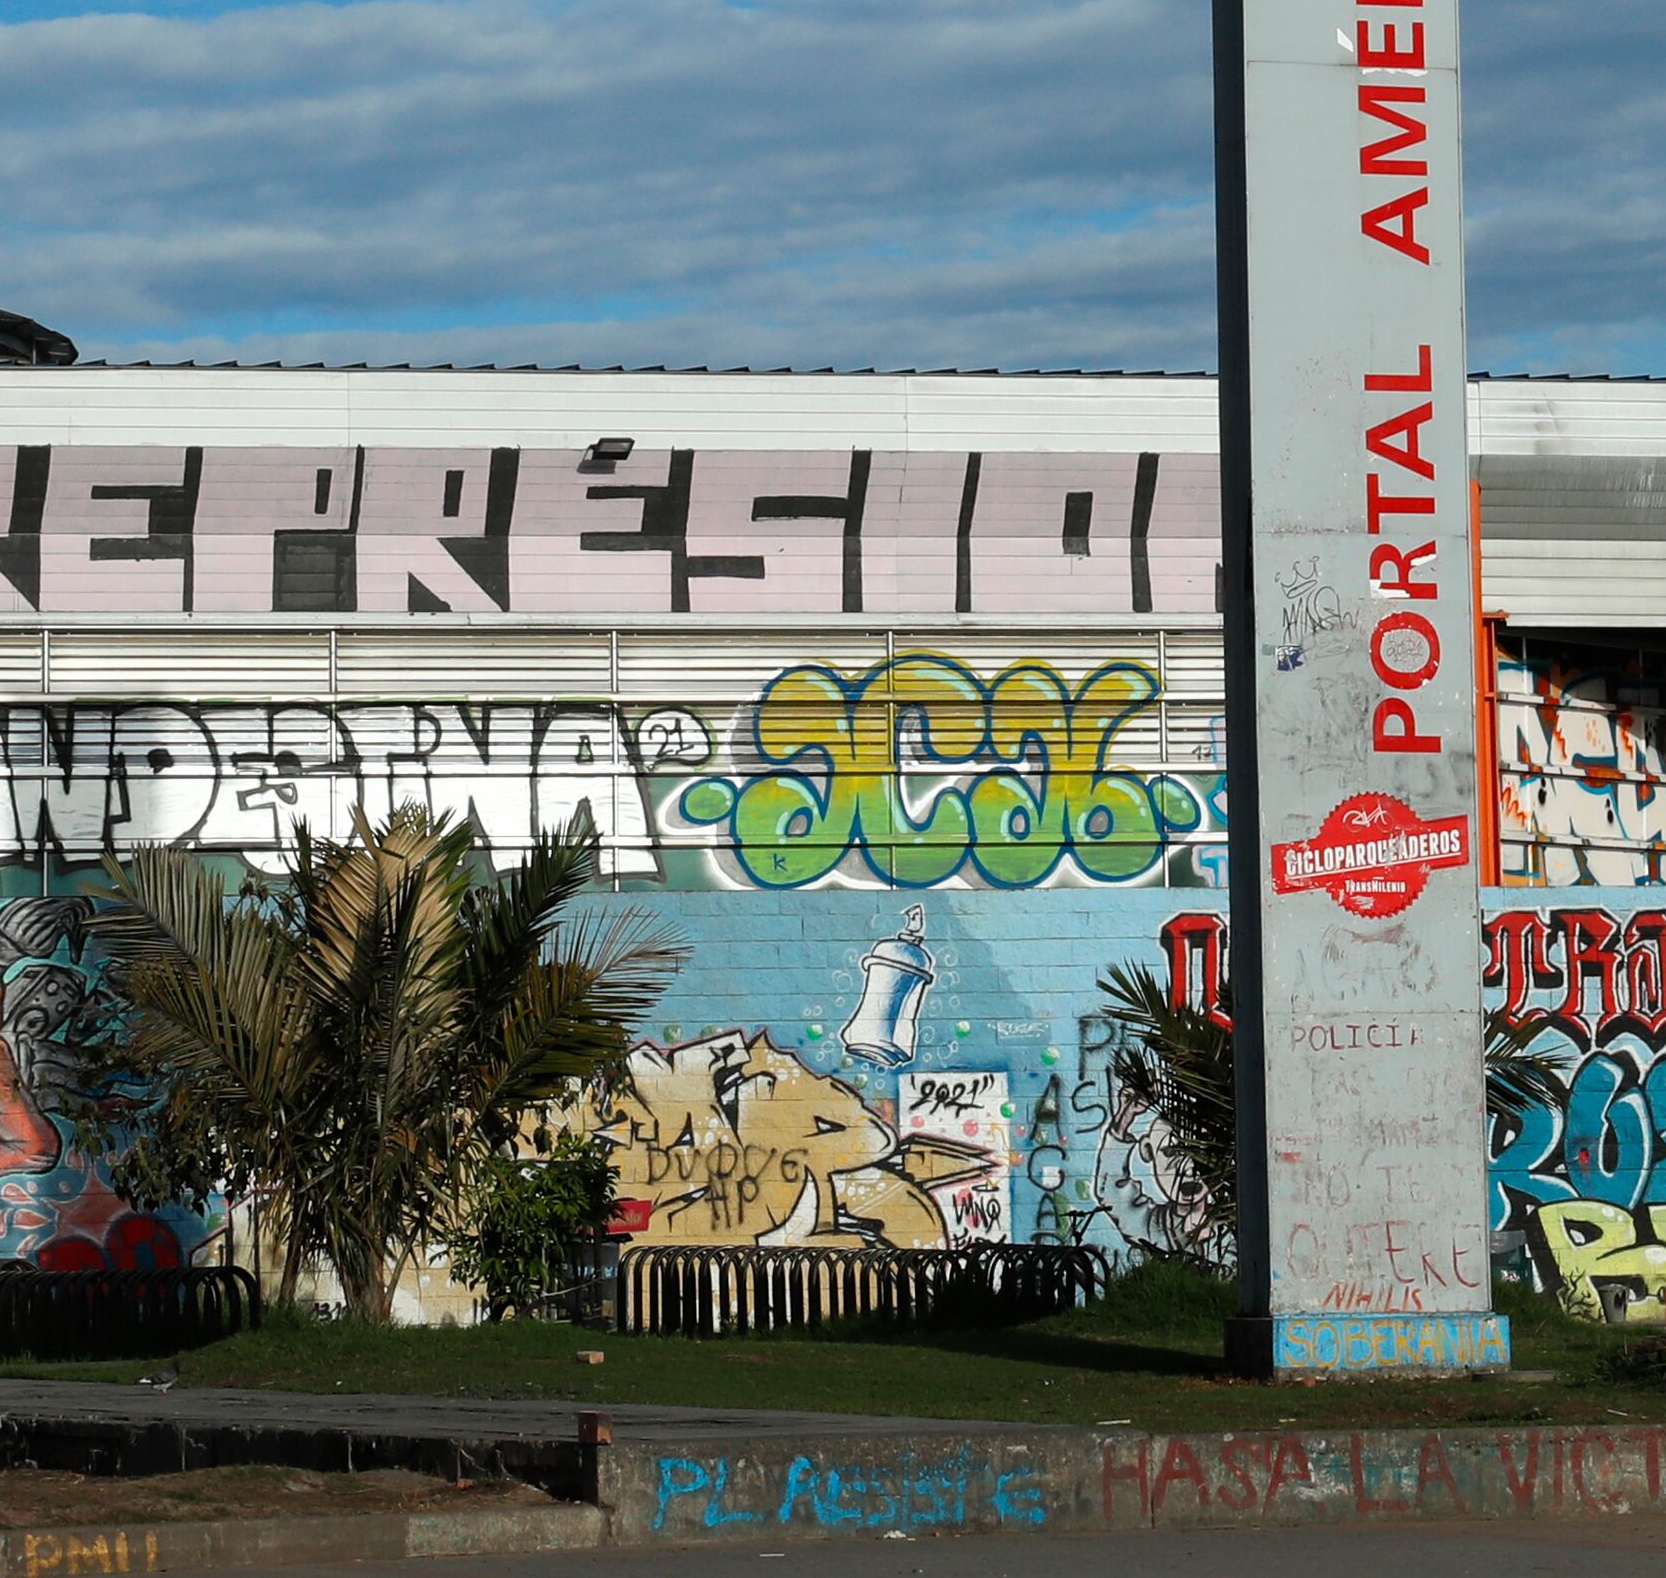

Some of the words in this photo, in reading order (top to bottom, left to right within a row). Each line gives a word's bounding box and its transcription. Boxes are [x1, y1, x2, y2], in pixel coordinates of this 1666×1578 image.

[1364, 343, 1442, 753] PORTAL
[1285, 828, 1462, 877] CICLOPARQUEADEROS
[1349, 1431, 1467, 1515] LA
